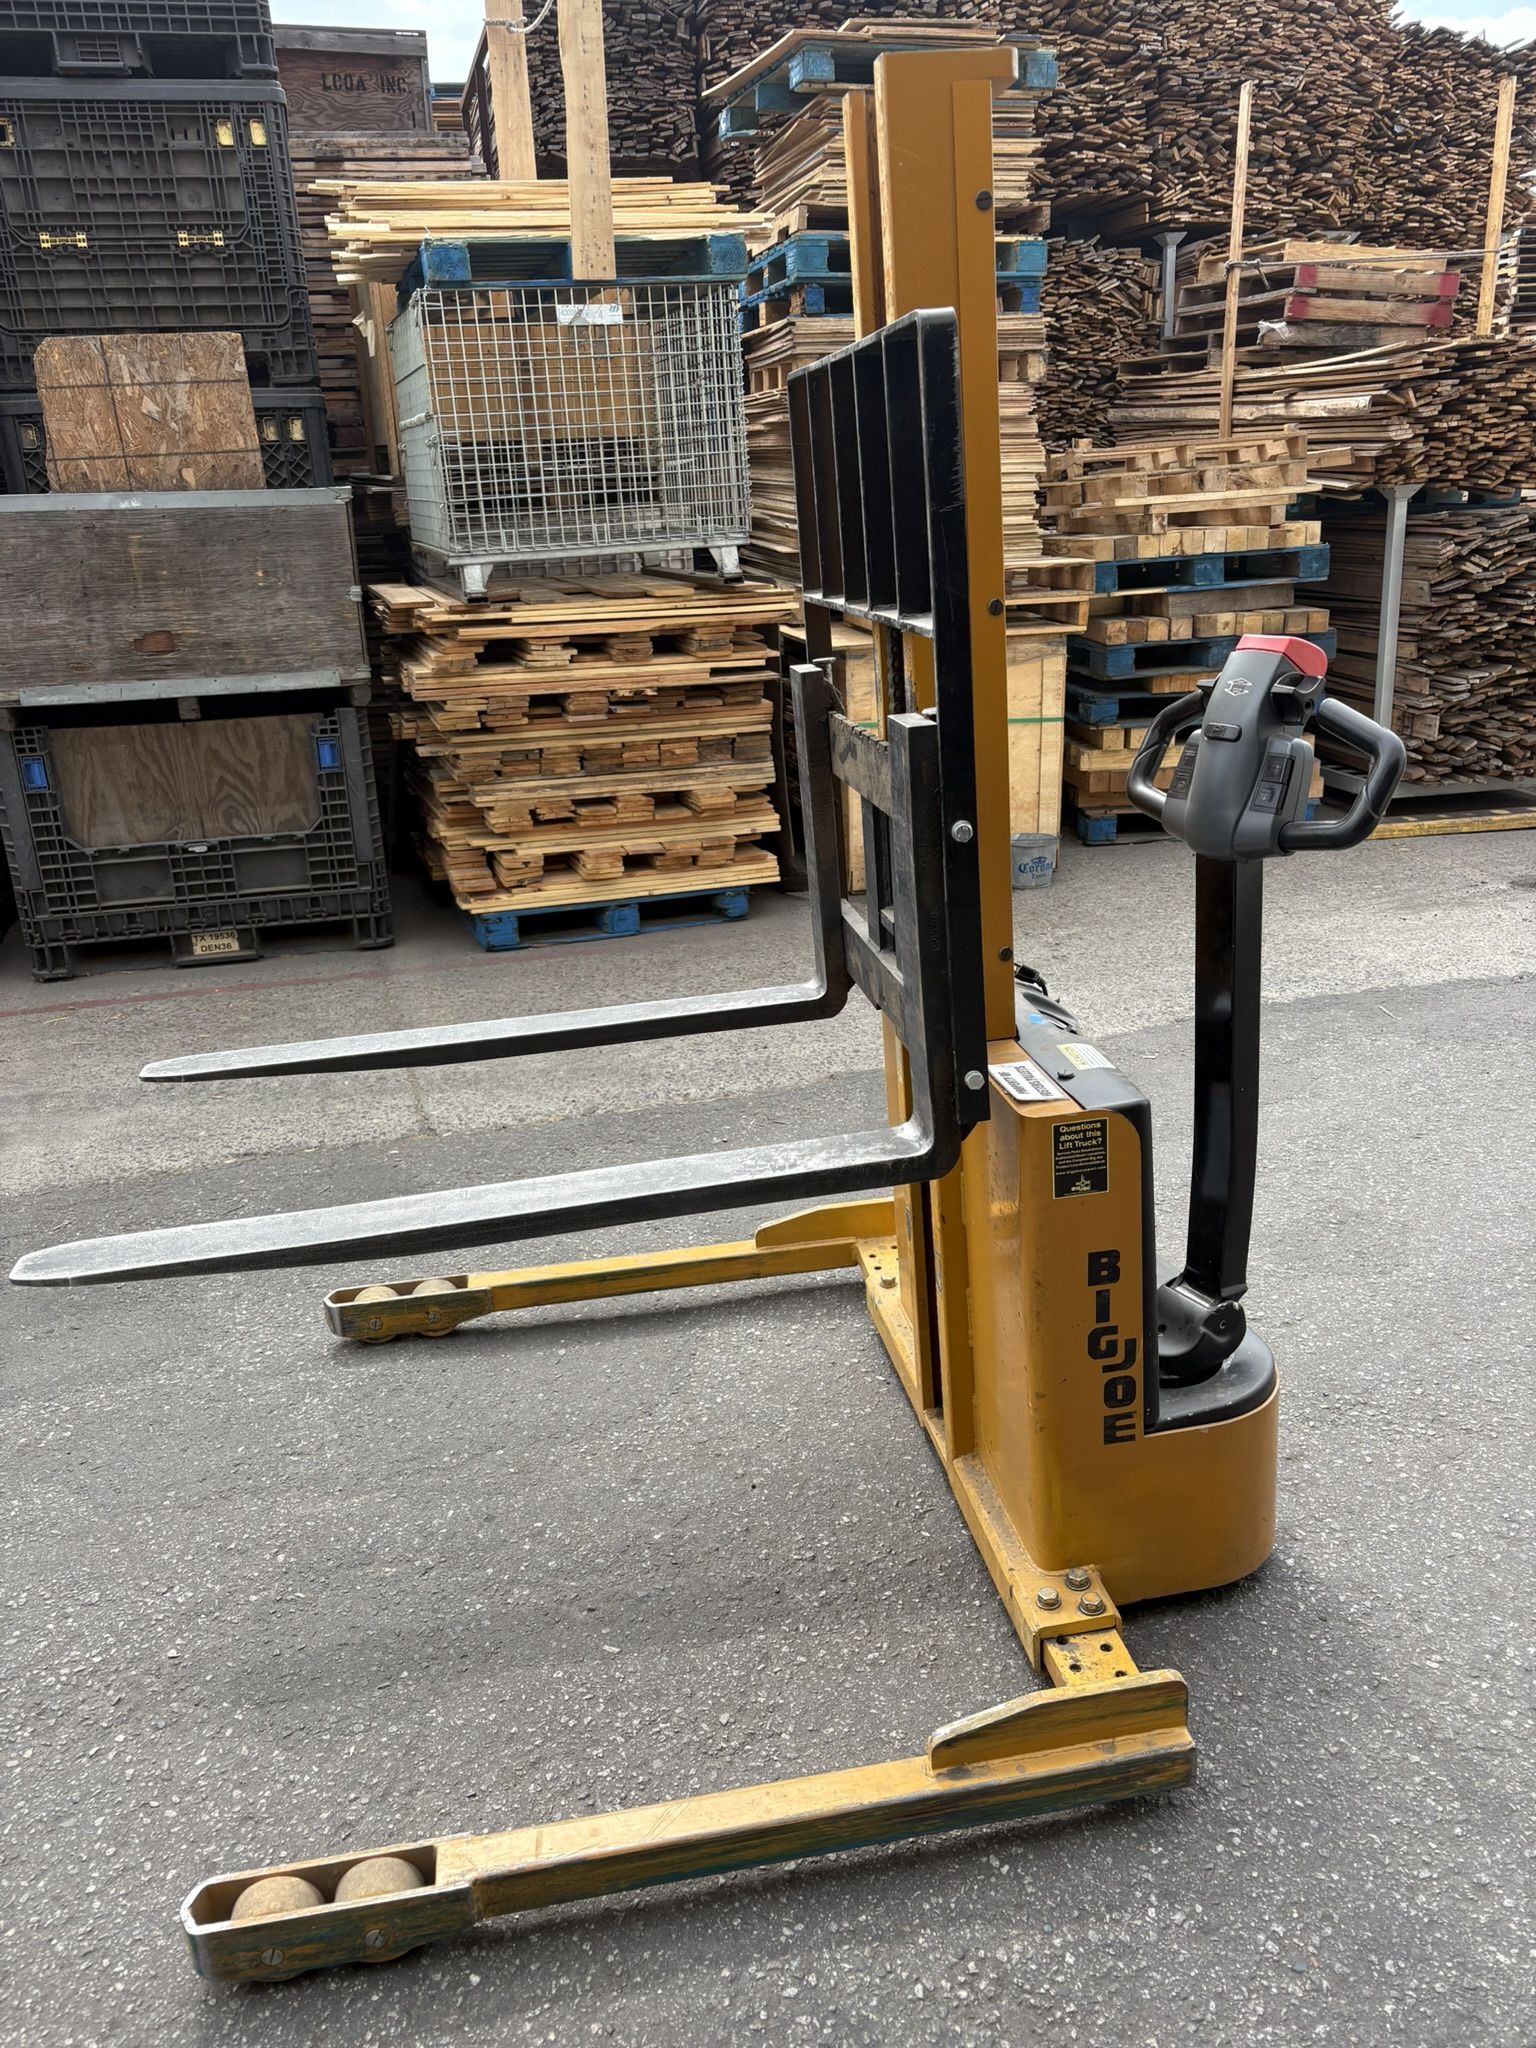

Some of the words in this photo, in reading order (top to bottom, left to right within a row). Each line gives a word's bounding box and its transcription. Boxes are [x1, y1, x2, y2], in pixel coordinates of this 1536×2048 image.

[193, 934, 206, 942] TX
[200, 943, 233, 953] DEN36
[1059, 1122, 1101, 1133] Questions
[1060, 1132, 1084, 1142] about
[1086, 1129, 1101, 1138] this
[1059, 1142, 1073, 1150] Lift
[1074, 1137, 1103, 1148] Truck?
